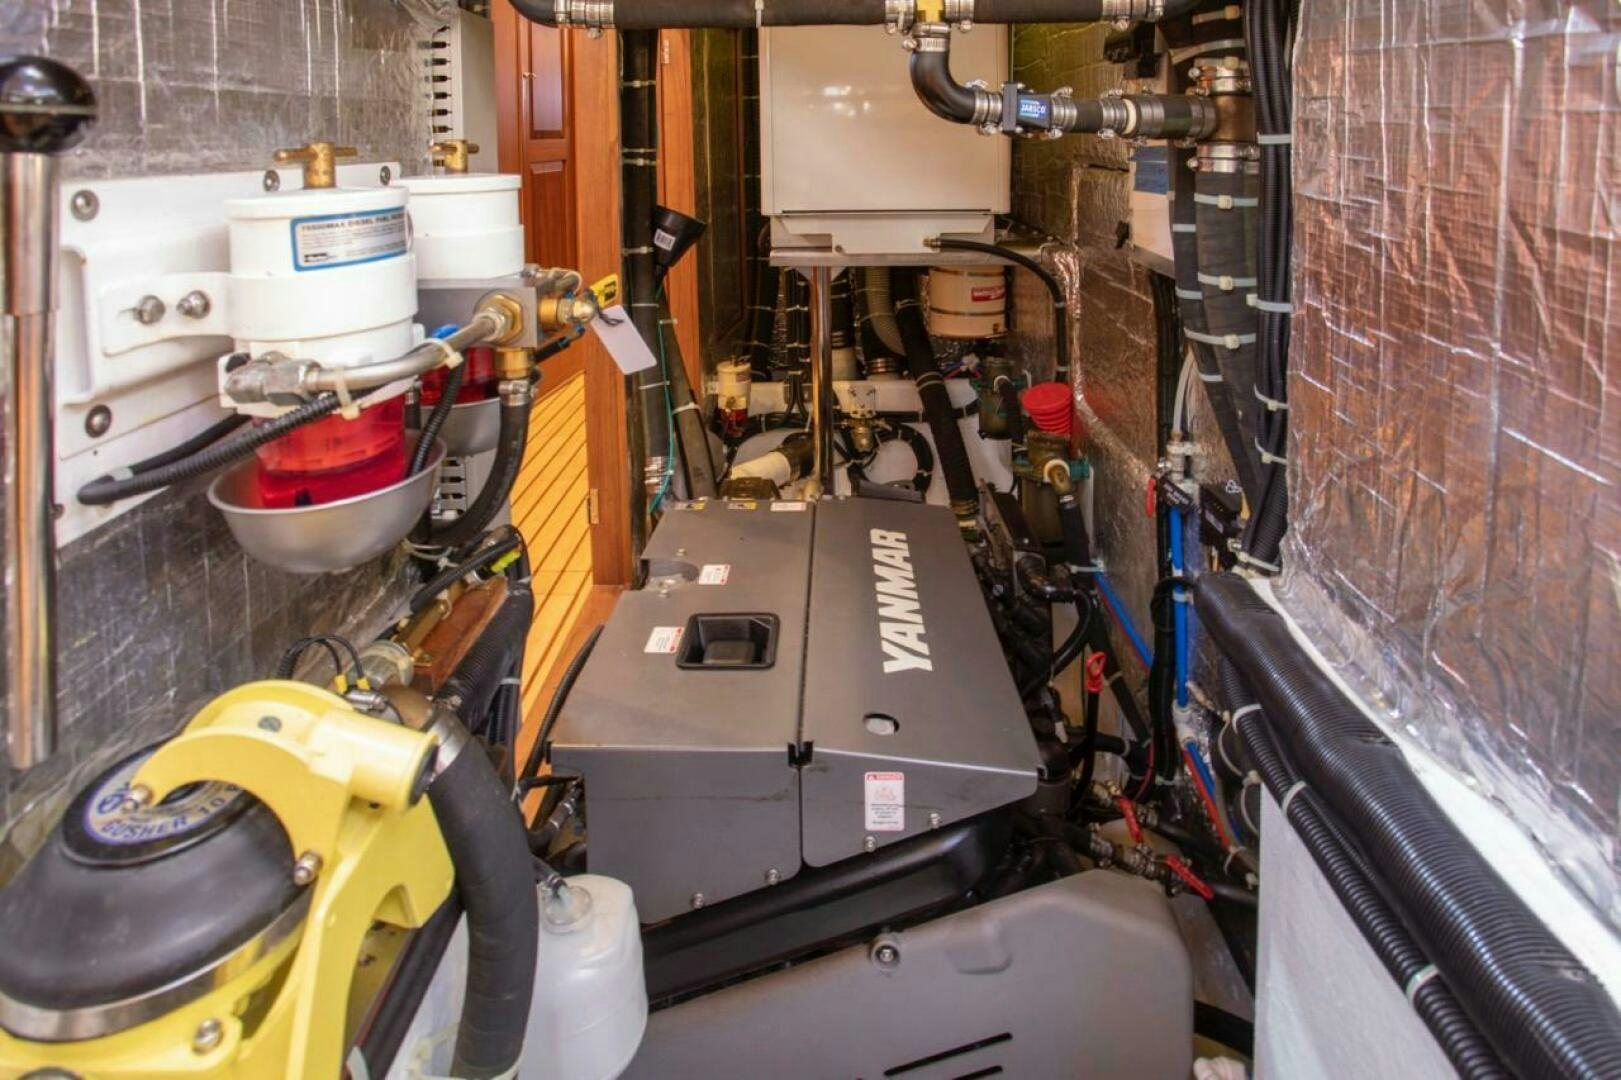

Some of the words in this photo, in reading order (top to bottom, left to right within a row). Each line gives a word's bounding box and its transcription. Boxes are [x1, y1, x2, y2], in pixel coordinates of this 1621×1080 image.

[870, 528, 933, 674] YANMAR
[101, 815, 188, 838] GUSHER
[199, 797, 226, 816] 10
